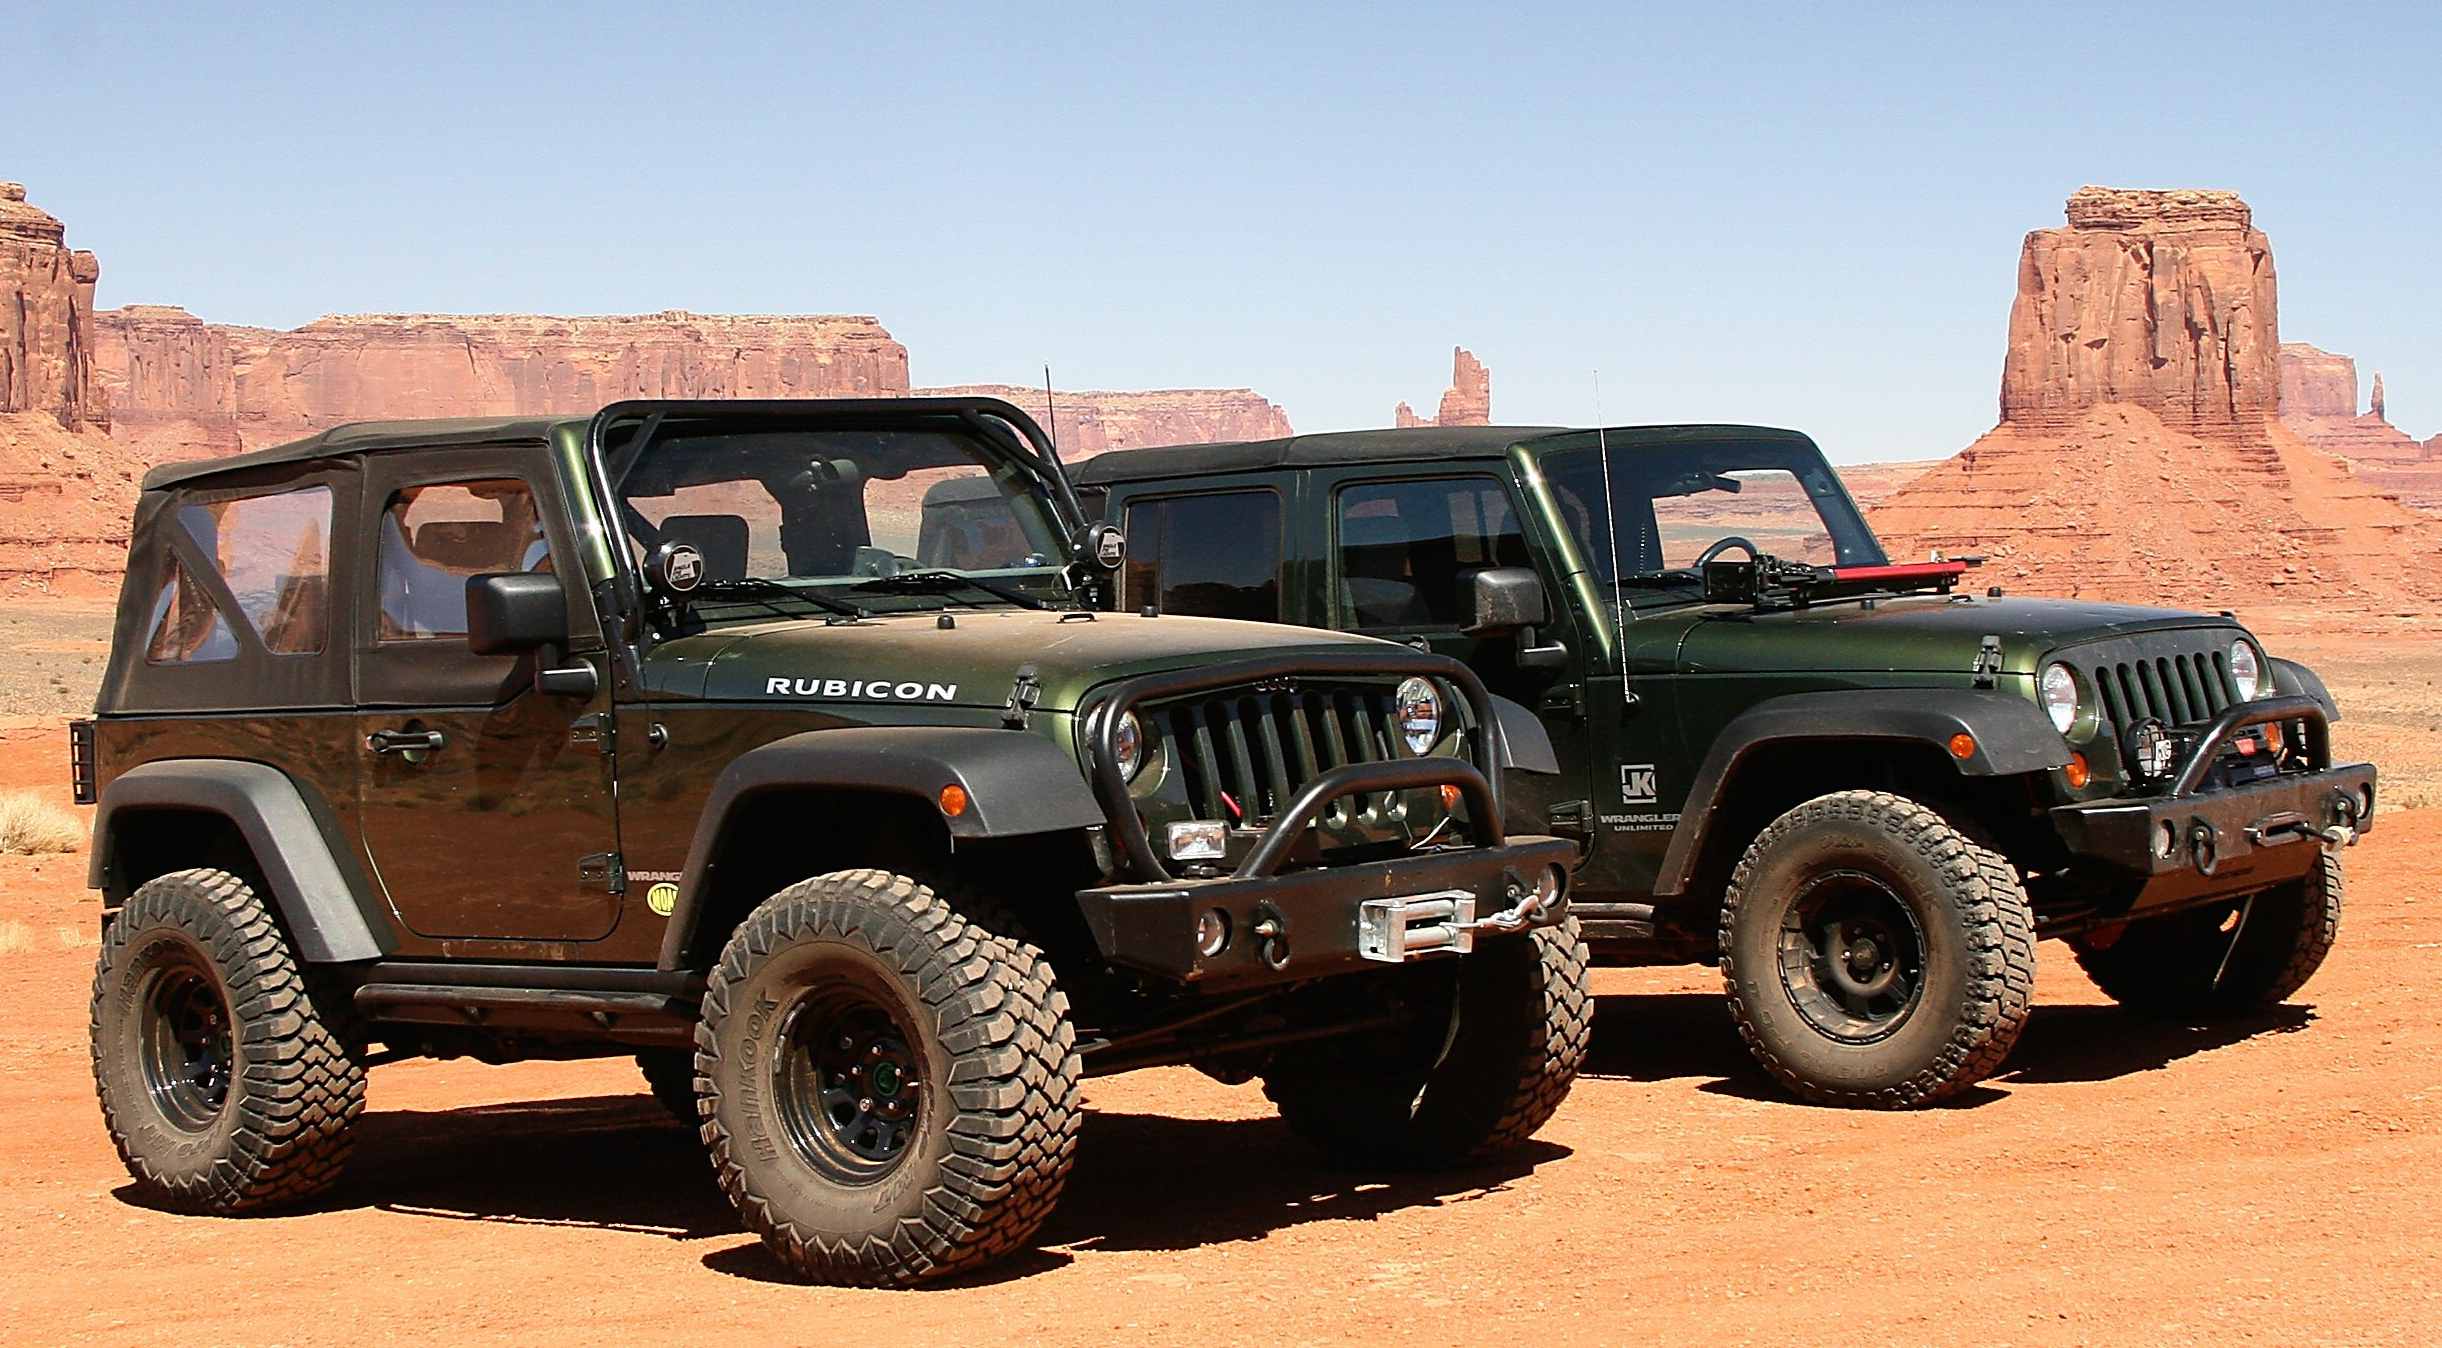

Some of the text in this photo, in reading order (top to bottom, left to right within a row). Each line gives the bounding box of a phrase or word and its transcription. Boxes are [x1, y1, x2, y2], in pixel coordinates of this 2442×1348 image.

[766, 677, 957, 700] RUBICON
[1621, 770, 1656, 797] JK
[1600, 814, 1681, 823] WRANGLER
[627, 871, 682, 881] WRANG
